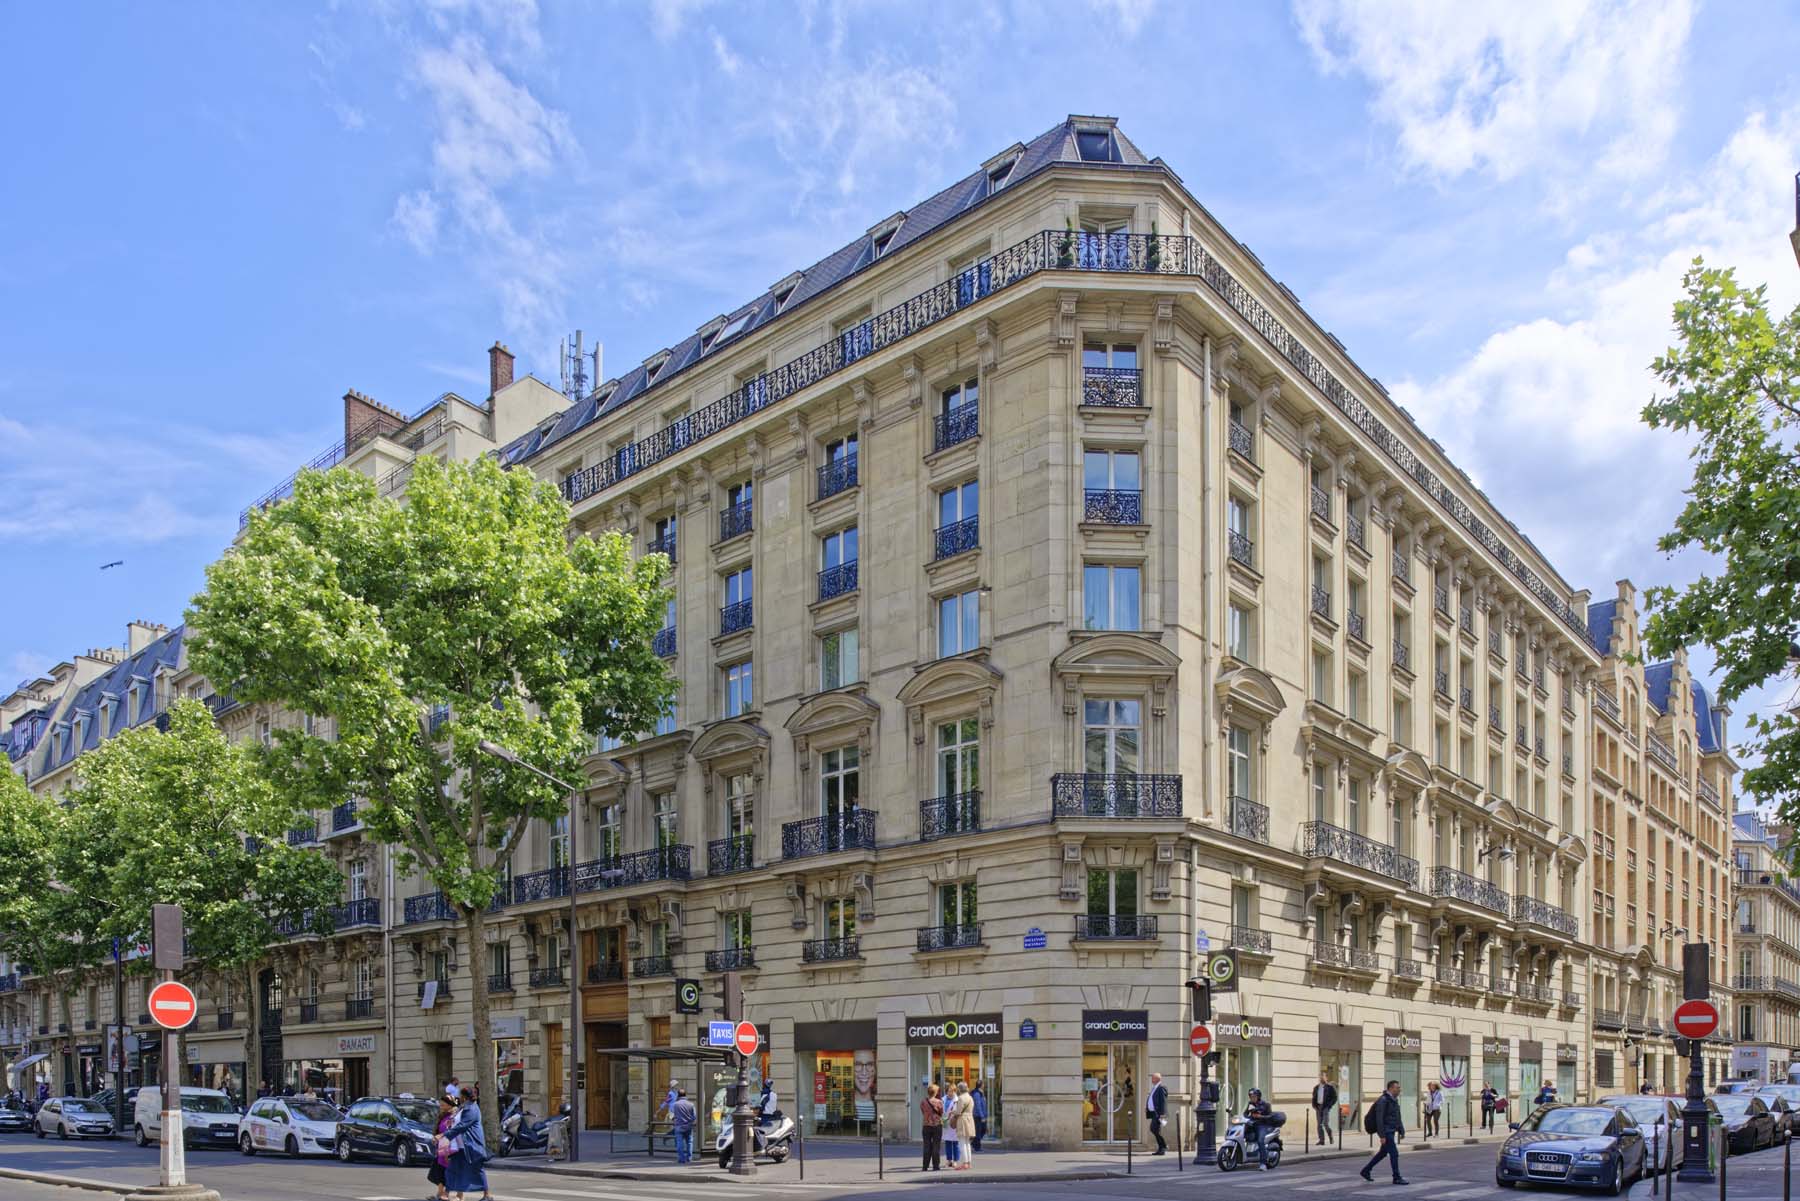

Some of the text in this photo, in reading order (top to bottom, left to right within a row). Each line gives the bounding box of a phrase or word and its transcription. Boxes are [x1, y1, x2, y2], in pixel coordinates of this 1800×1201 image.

[1213, 959, 1230, 977] G
[712, 1028, 733, 1039] TAXIS
[338, 1037, 372, 1051] DAMART
